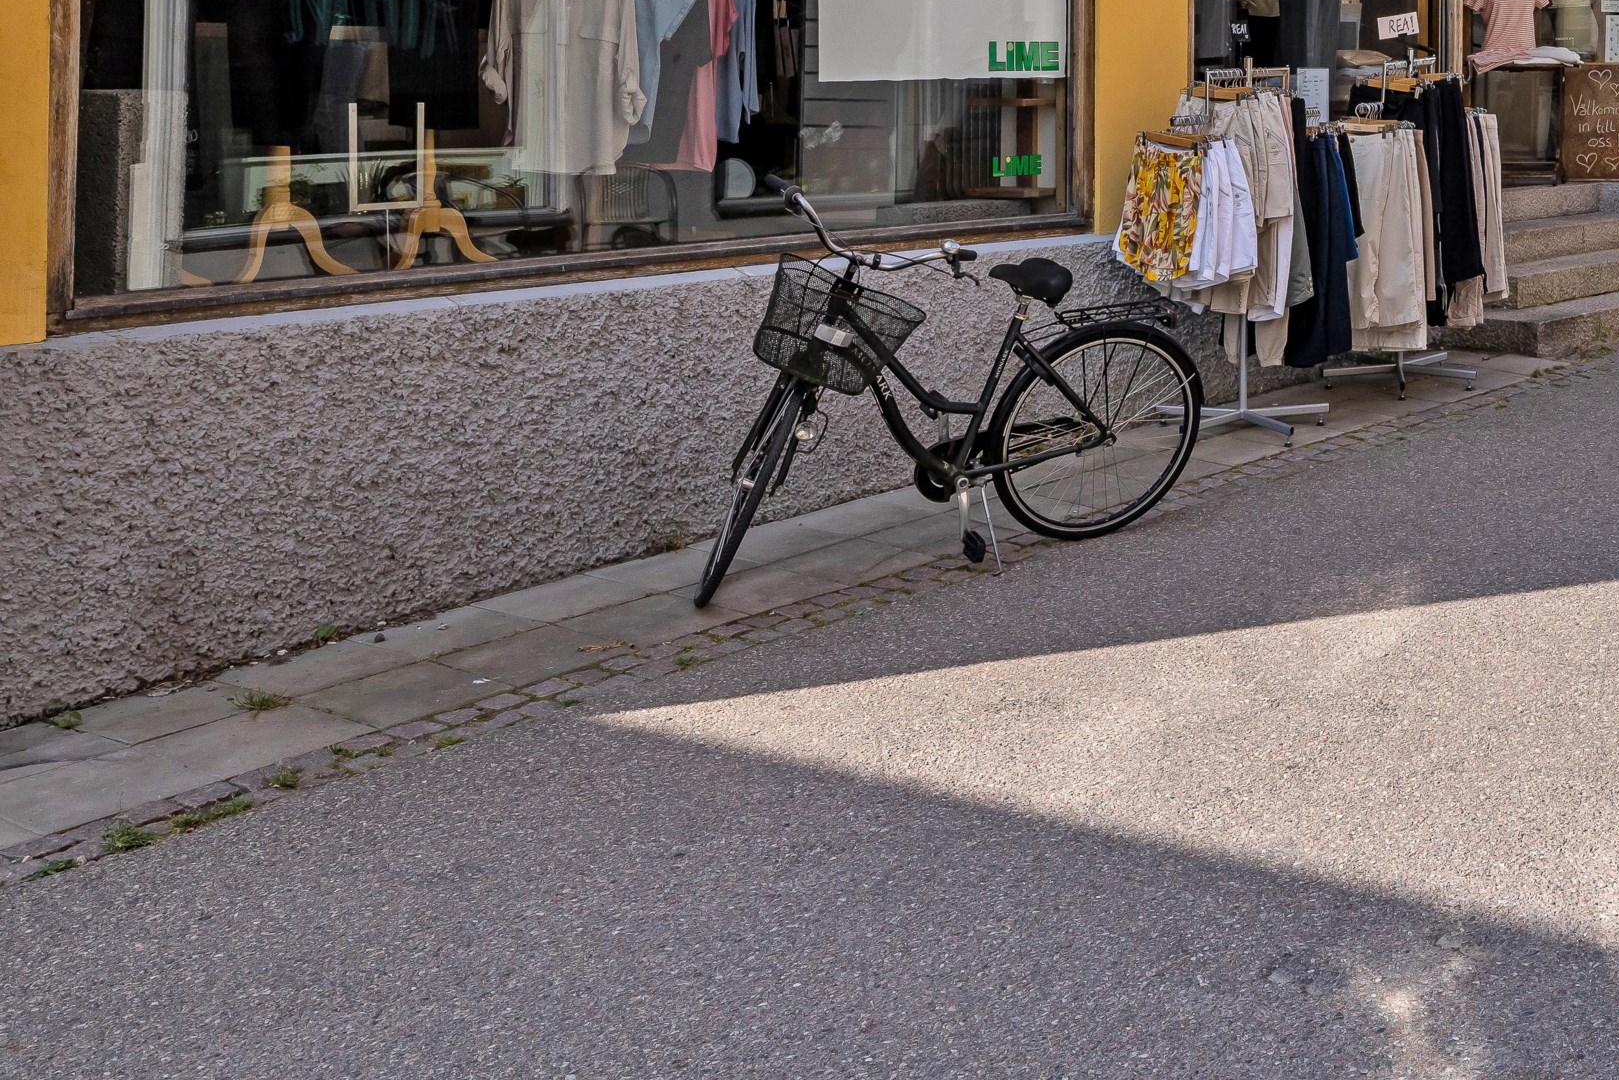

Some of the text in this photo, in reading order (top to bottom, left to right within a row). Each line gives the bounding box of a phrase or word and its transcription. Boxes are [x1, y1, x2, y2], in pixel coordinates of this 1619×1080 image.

[1389, 15, 1415, 34] REA!
[1579, 120, 1616, 133] in till
